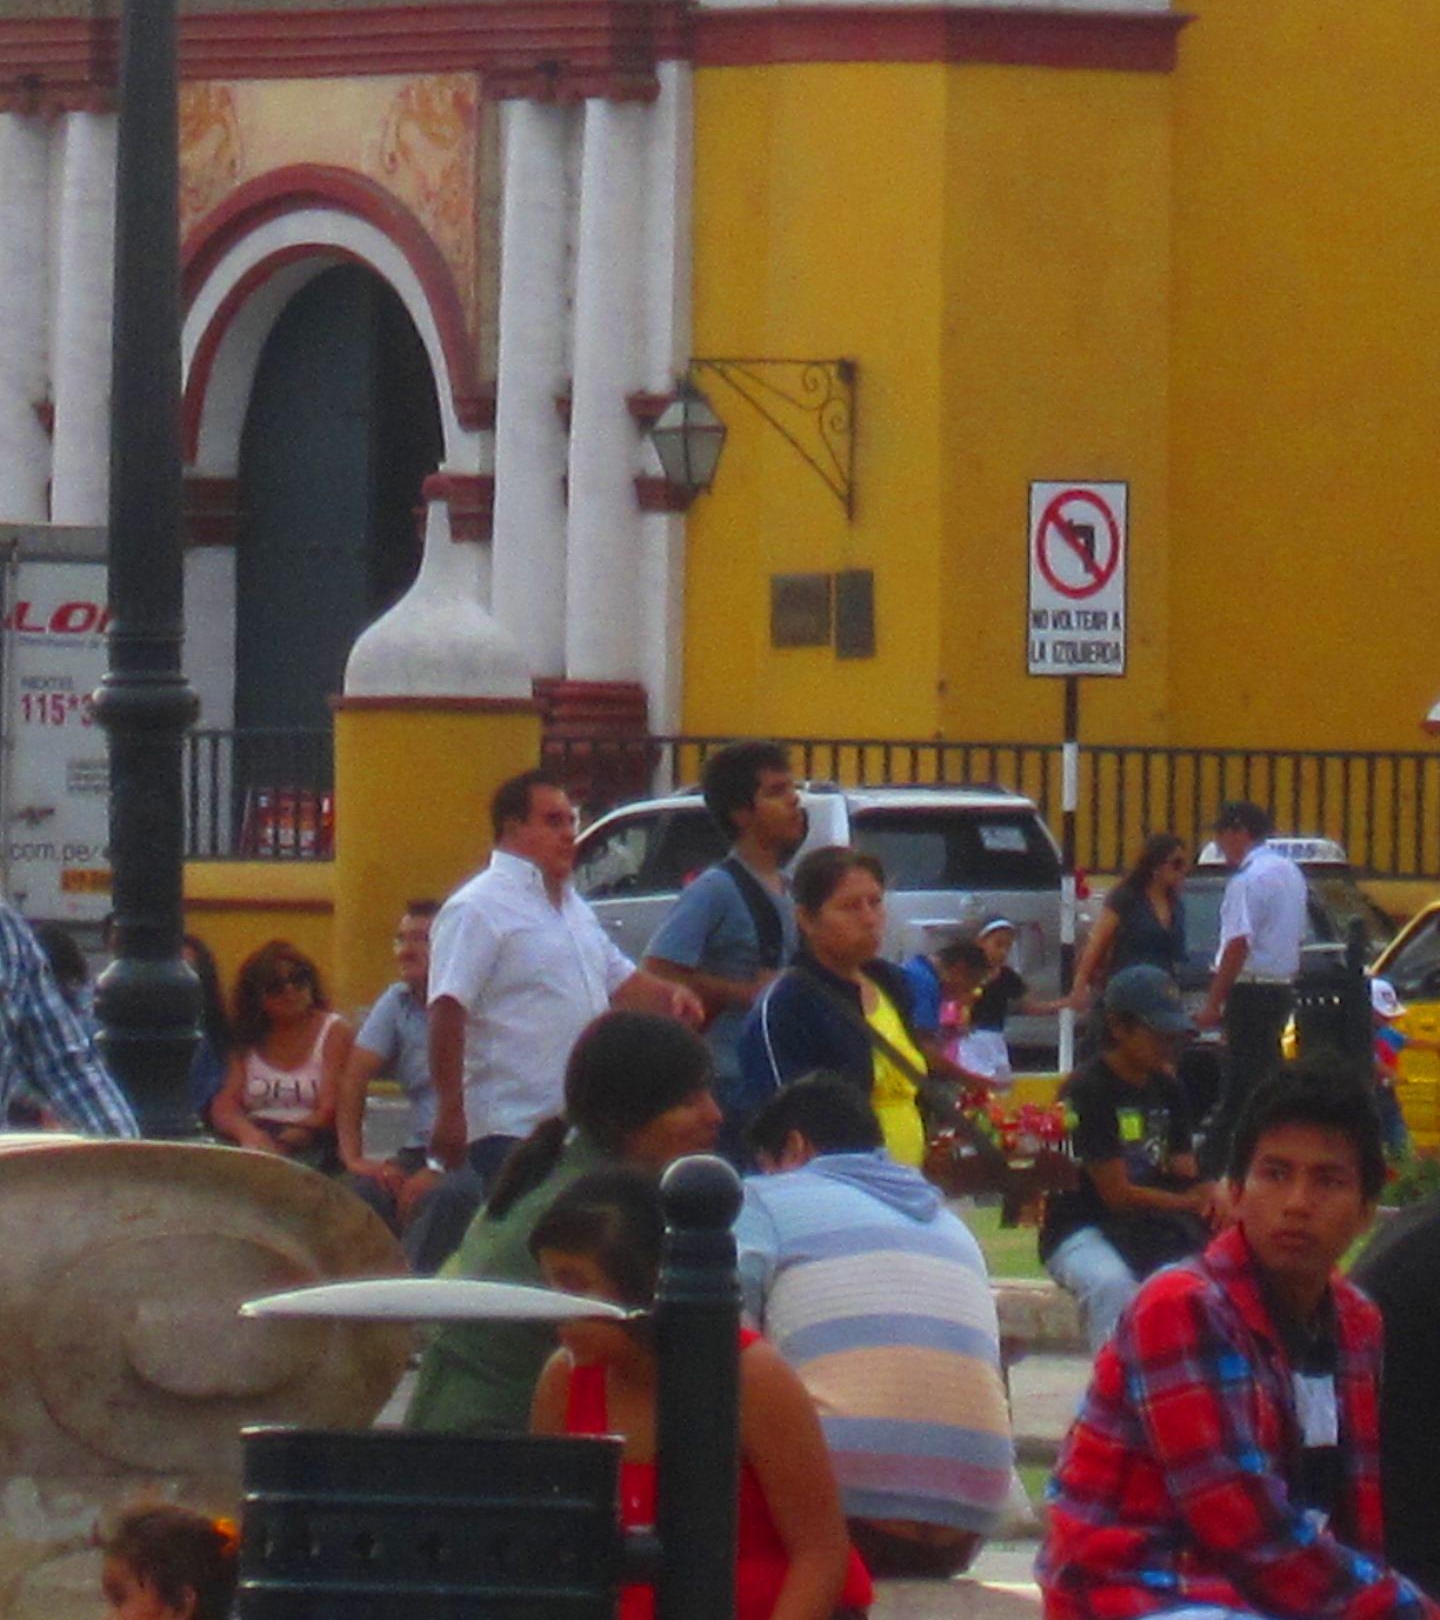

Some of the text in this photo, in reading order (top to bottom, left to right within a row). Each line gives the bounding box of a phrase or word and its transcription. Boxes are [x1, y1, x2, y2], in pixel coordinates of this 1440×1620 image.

[1032, 609, 1121, 631] NO VOLTEAR A
[1030, 641, 1121, 665] LA IZQUIERDA
